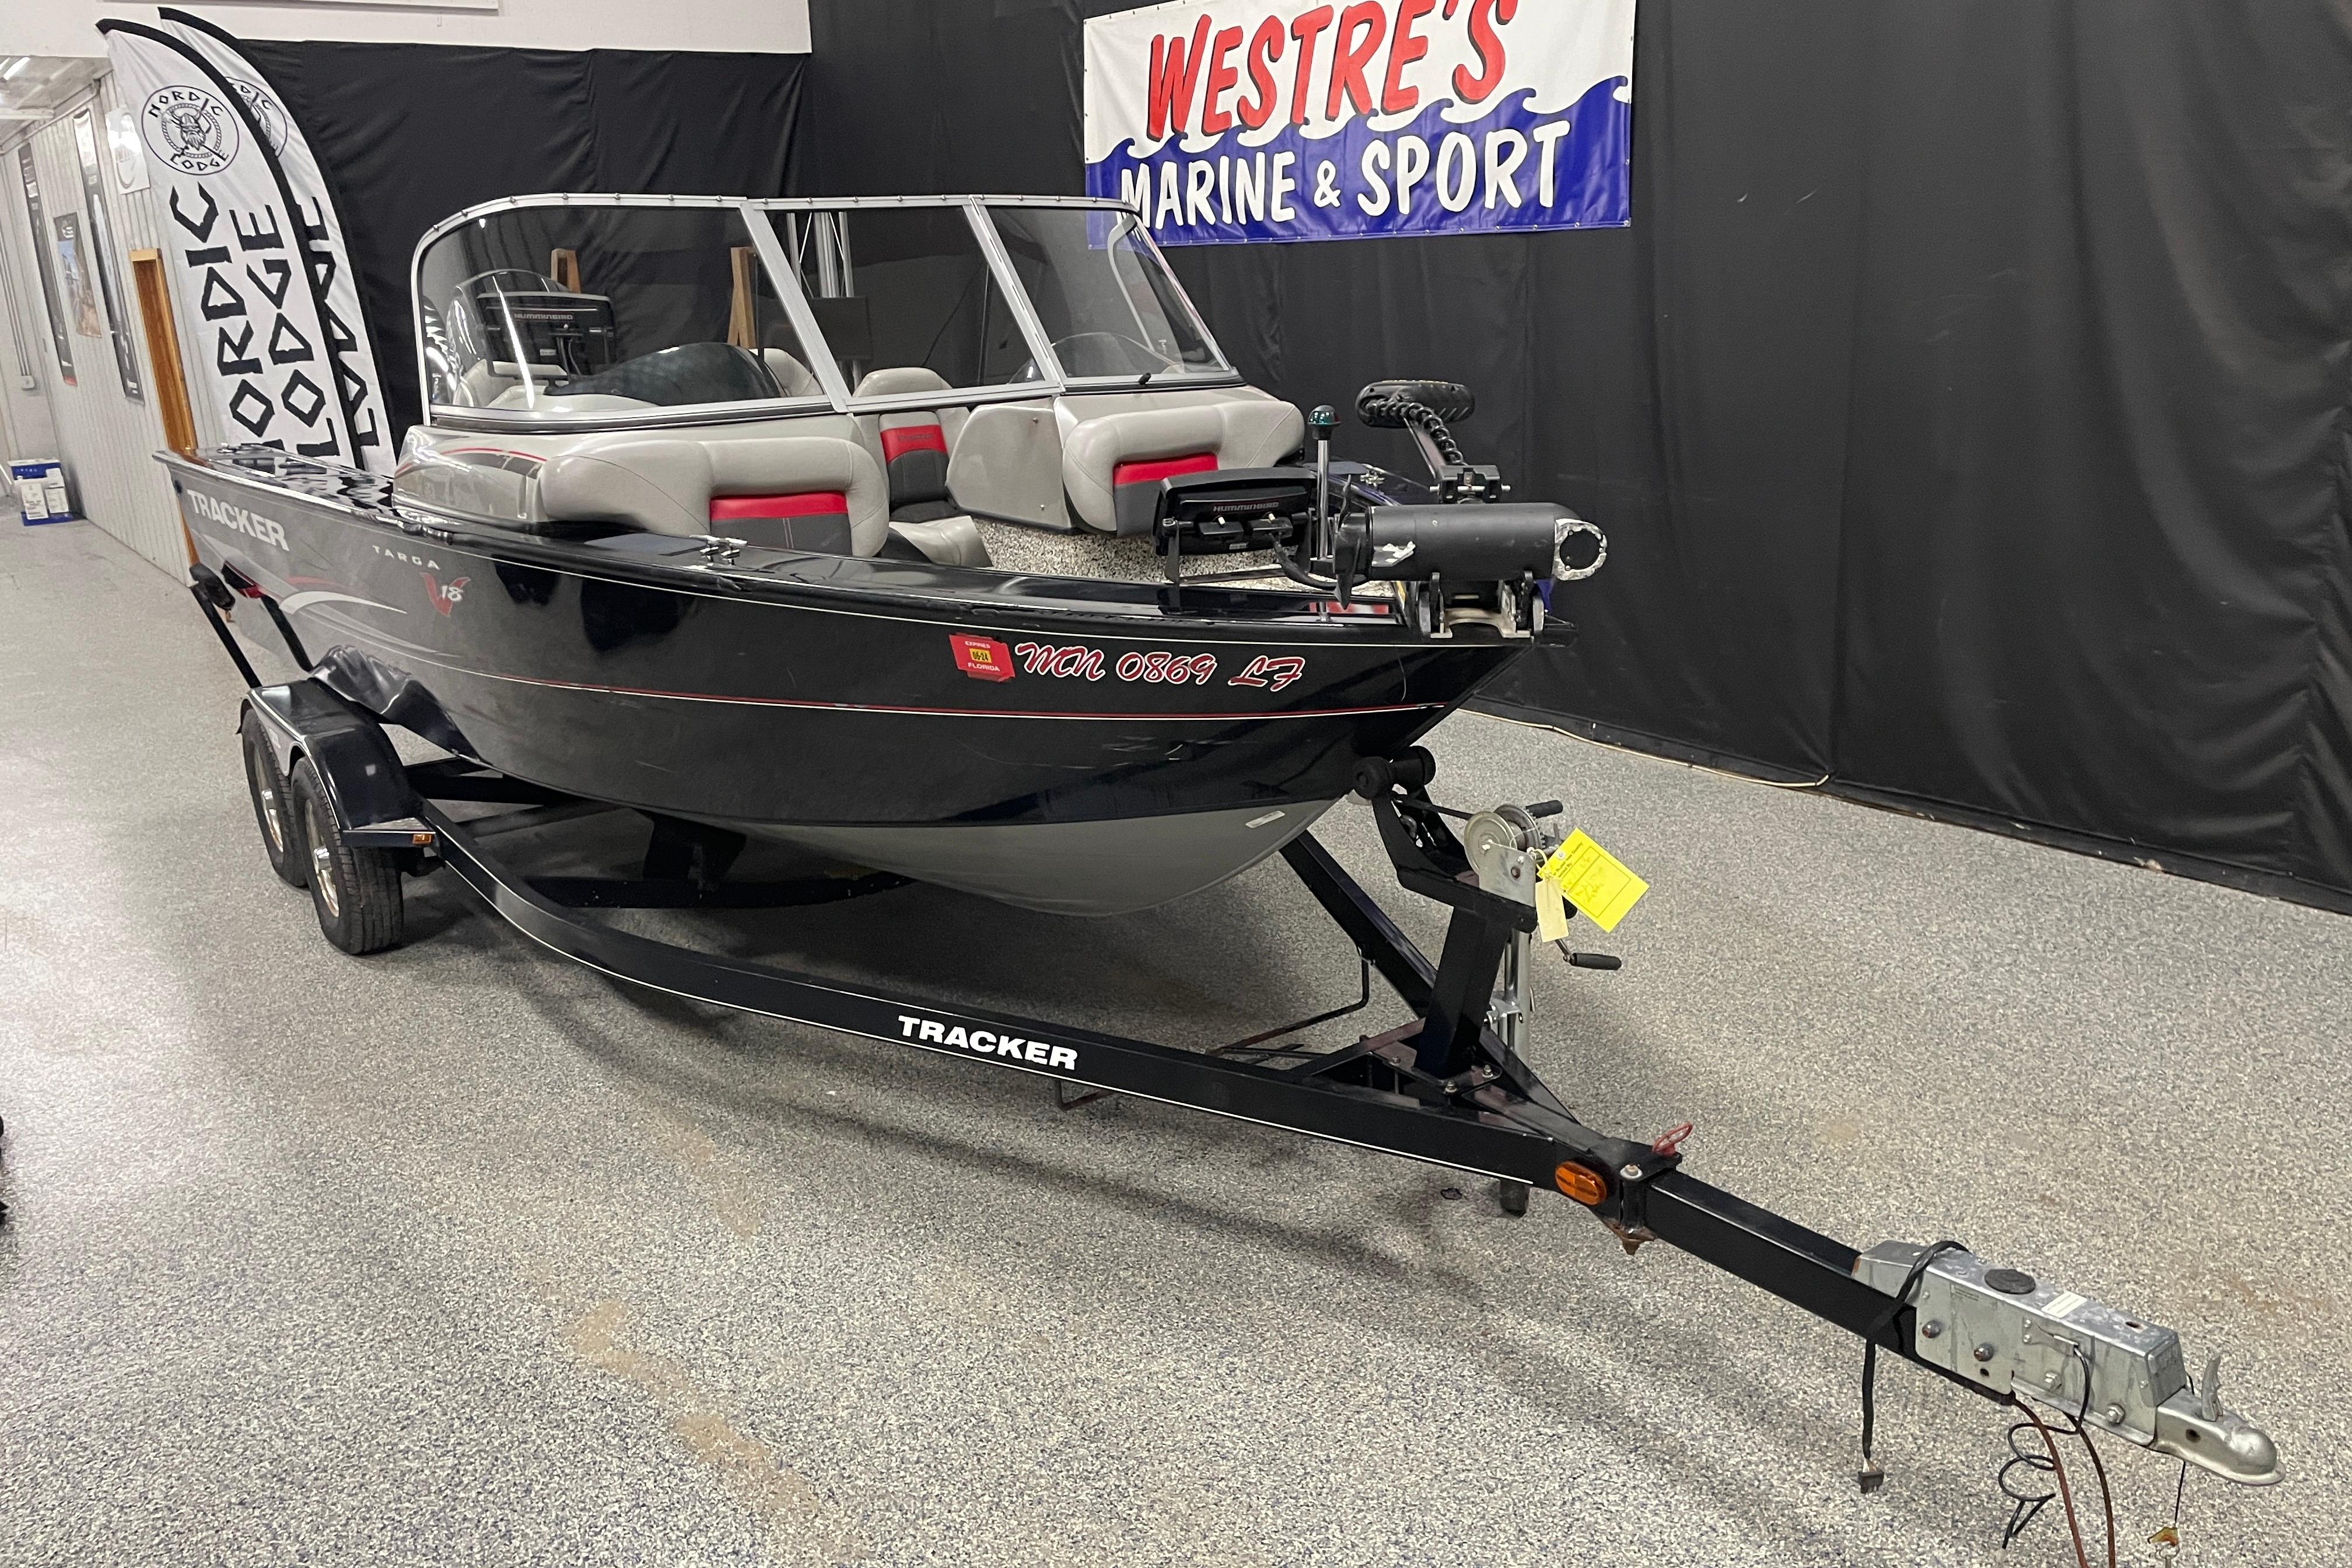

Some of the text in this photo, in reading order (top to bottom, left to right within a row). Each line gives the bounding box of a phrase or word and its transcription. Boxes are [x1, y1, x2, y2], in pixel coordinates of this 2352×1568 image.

[1147, 0, 1517, 142] WESTRE'S
[148, 91, 223, 118] NORDIC
[170, 149, 230, 171] LODGE
[1121, 121, 1571, 230] MARINE & SPORT
[229, 204, 340, 456] LODGE
[187, 489, 289, 551] TRACKER
[1213, 502, 1279, 512] HUMMINBIRD
[372, 545, 440, 570] TARGA
[968, 662, 1000, 671] FLORIDA
[1015, 642, 1105, 681] MN
[1115, 650, 1217, 685] 0869
[898, 1015, 1078, 1070] TRACKER
